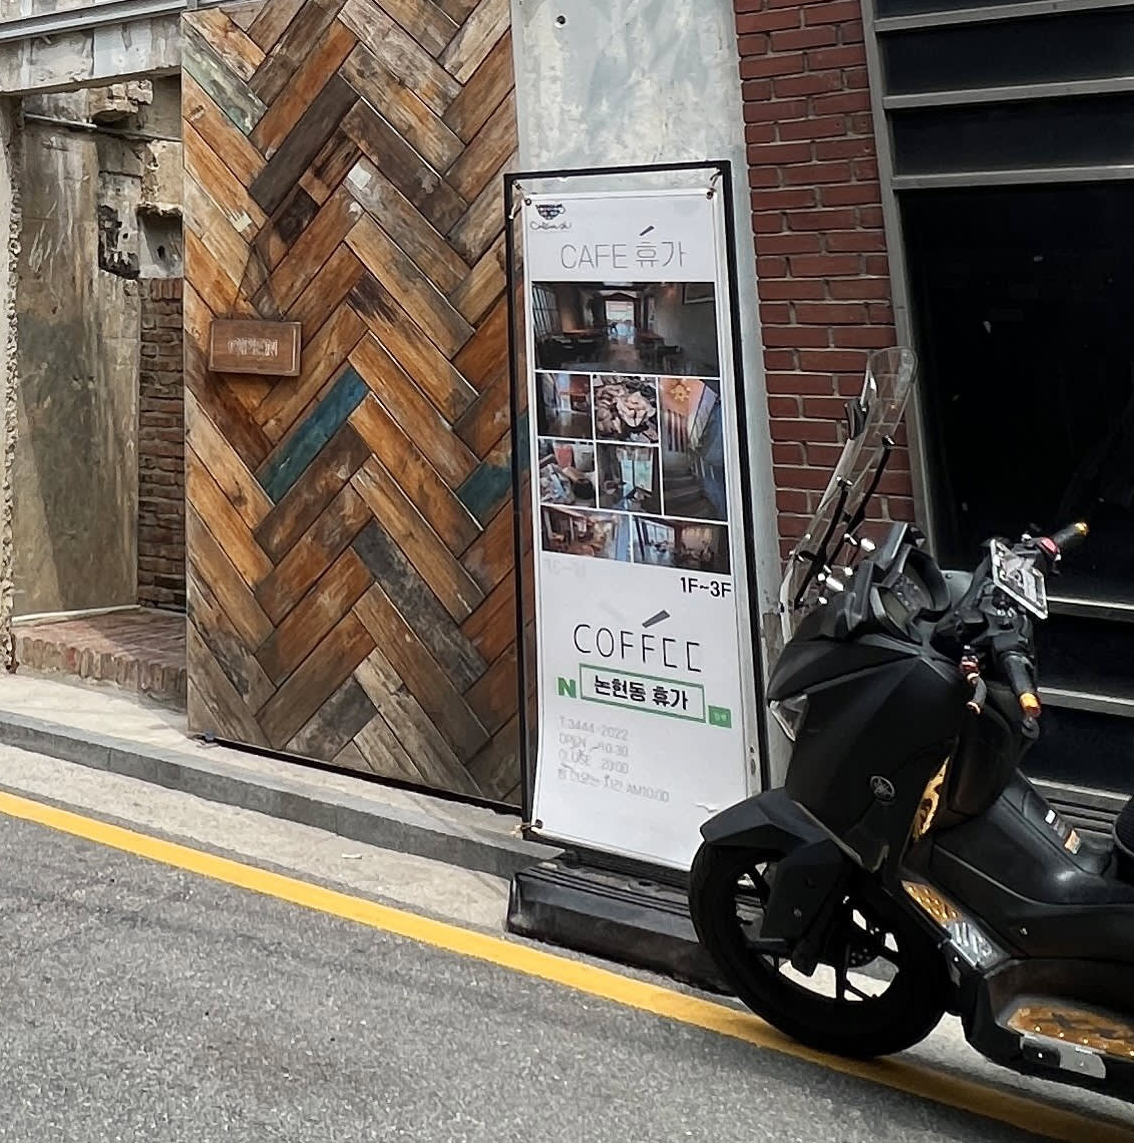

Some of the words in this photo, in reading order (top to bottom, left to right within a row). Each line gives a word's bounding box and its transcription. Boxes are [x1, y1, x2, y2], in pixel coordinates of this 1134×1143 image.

[560, 244, 628, 269] CAFE
[635, 239, 690, 268] 휴가
[680, 576, 732, 598] 1F~3F
[594, 675, 646, 702] 논현동
[652, 685, 688, 710] 휴가
